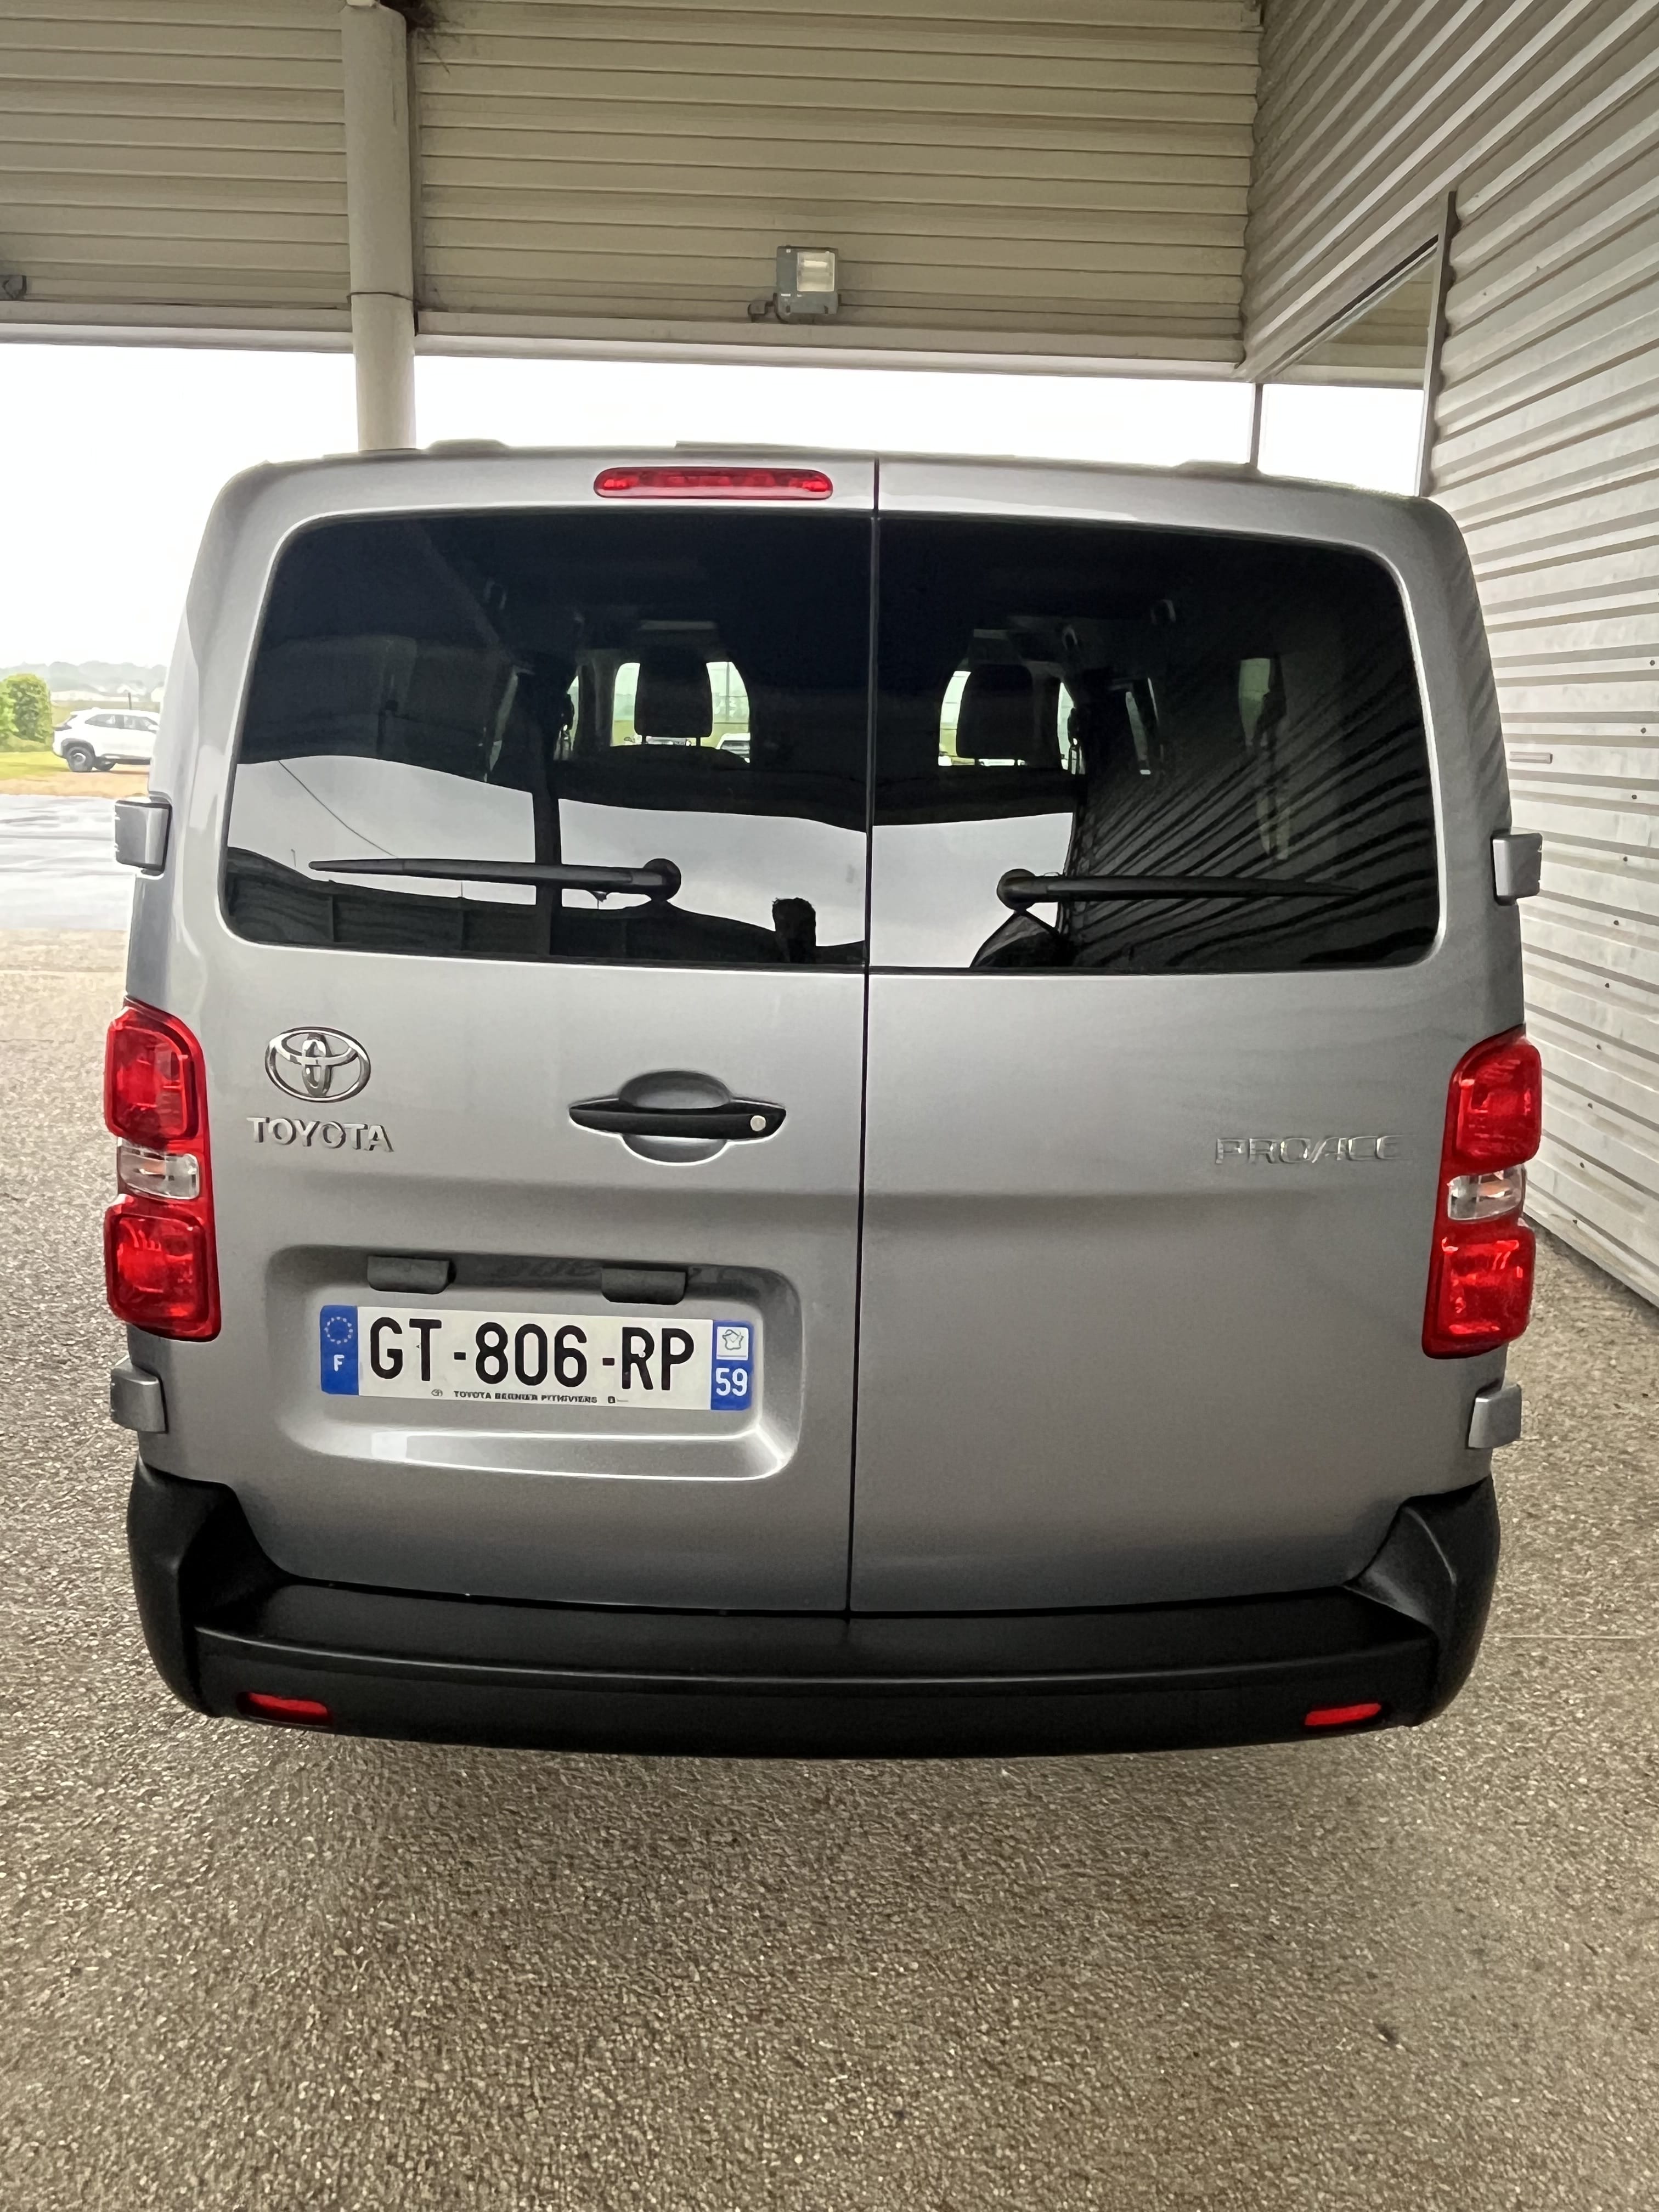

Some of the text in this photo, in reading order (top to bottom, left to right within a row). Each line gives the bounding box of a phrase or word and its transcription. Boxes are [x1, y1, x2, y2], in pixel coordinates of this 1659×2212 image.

[246, 1116, 393, 1152] TOYOTA
[1216, 1135, 1407, 1164] PROACE
[334, 1354, 343, 1372] F
[369, 1317, 695, 1391] GT-806-RP
[454, 1391, 492, 1400] TOYOTA
[715, 1368, 748, 1396] 59
